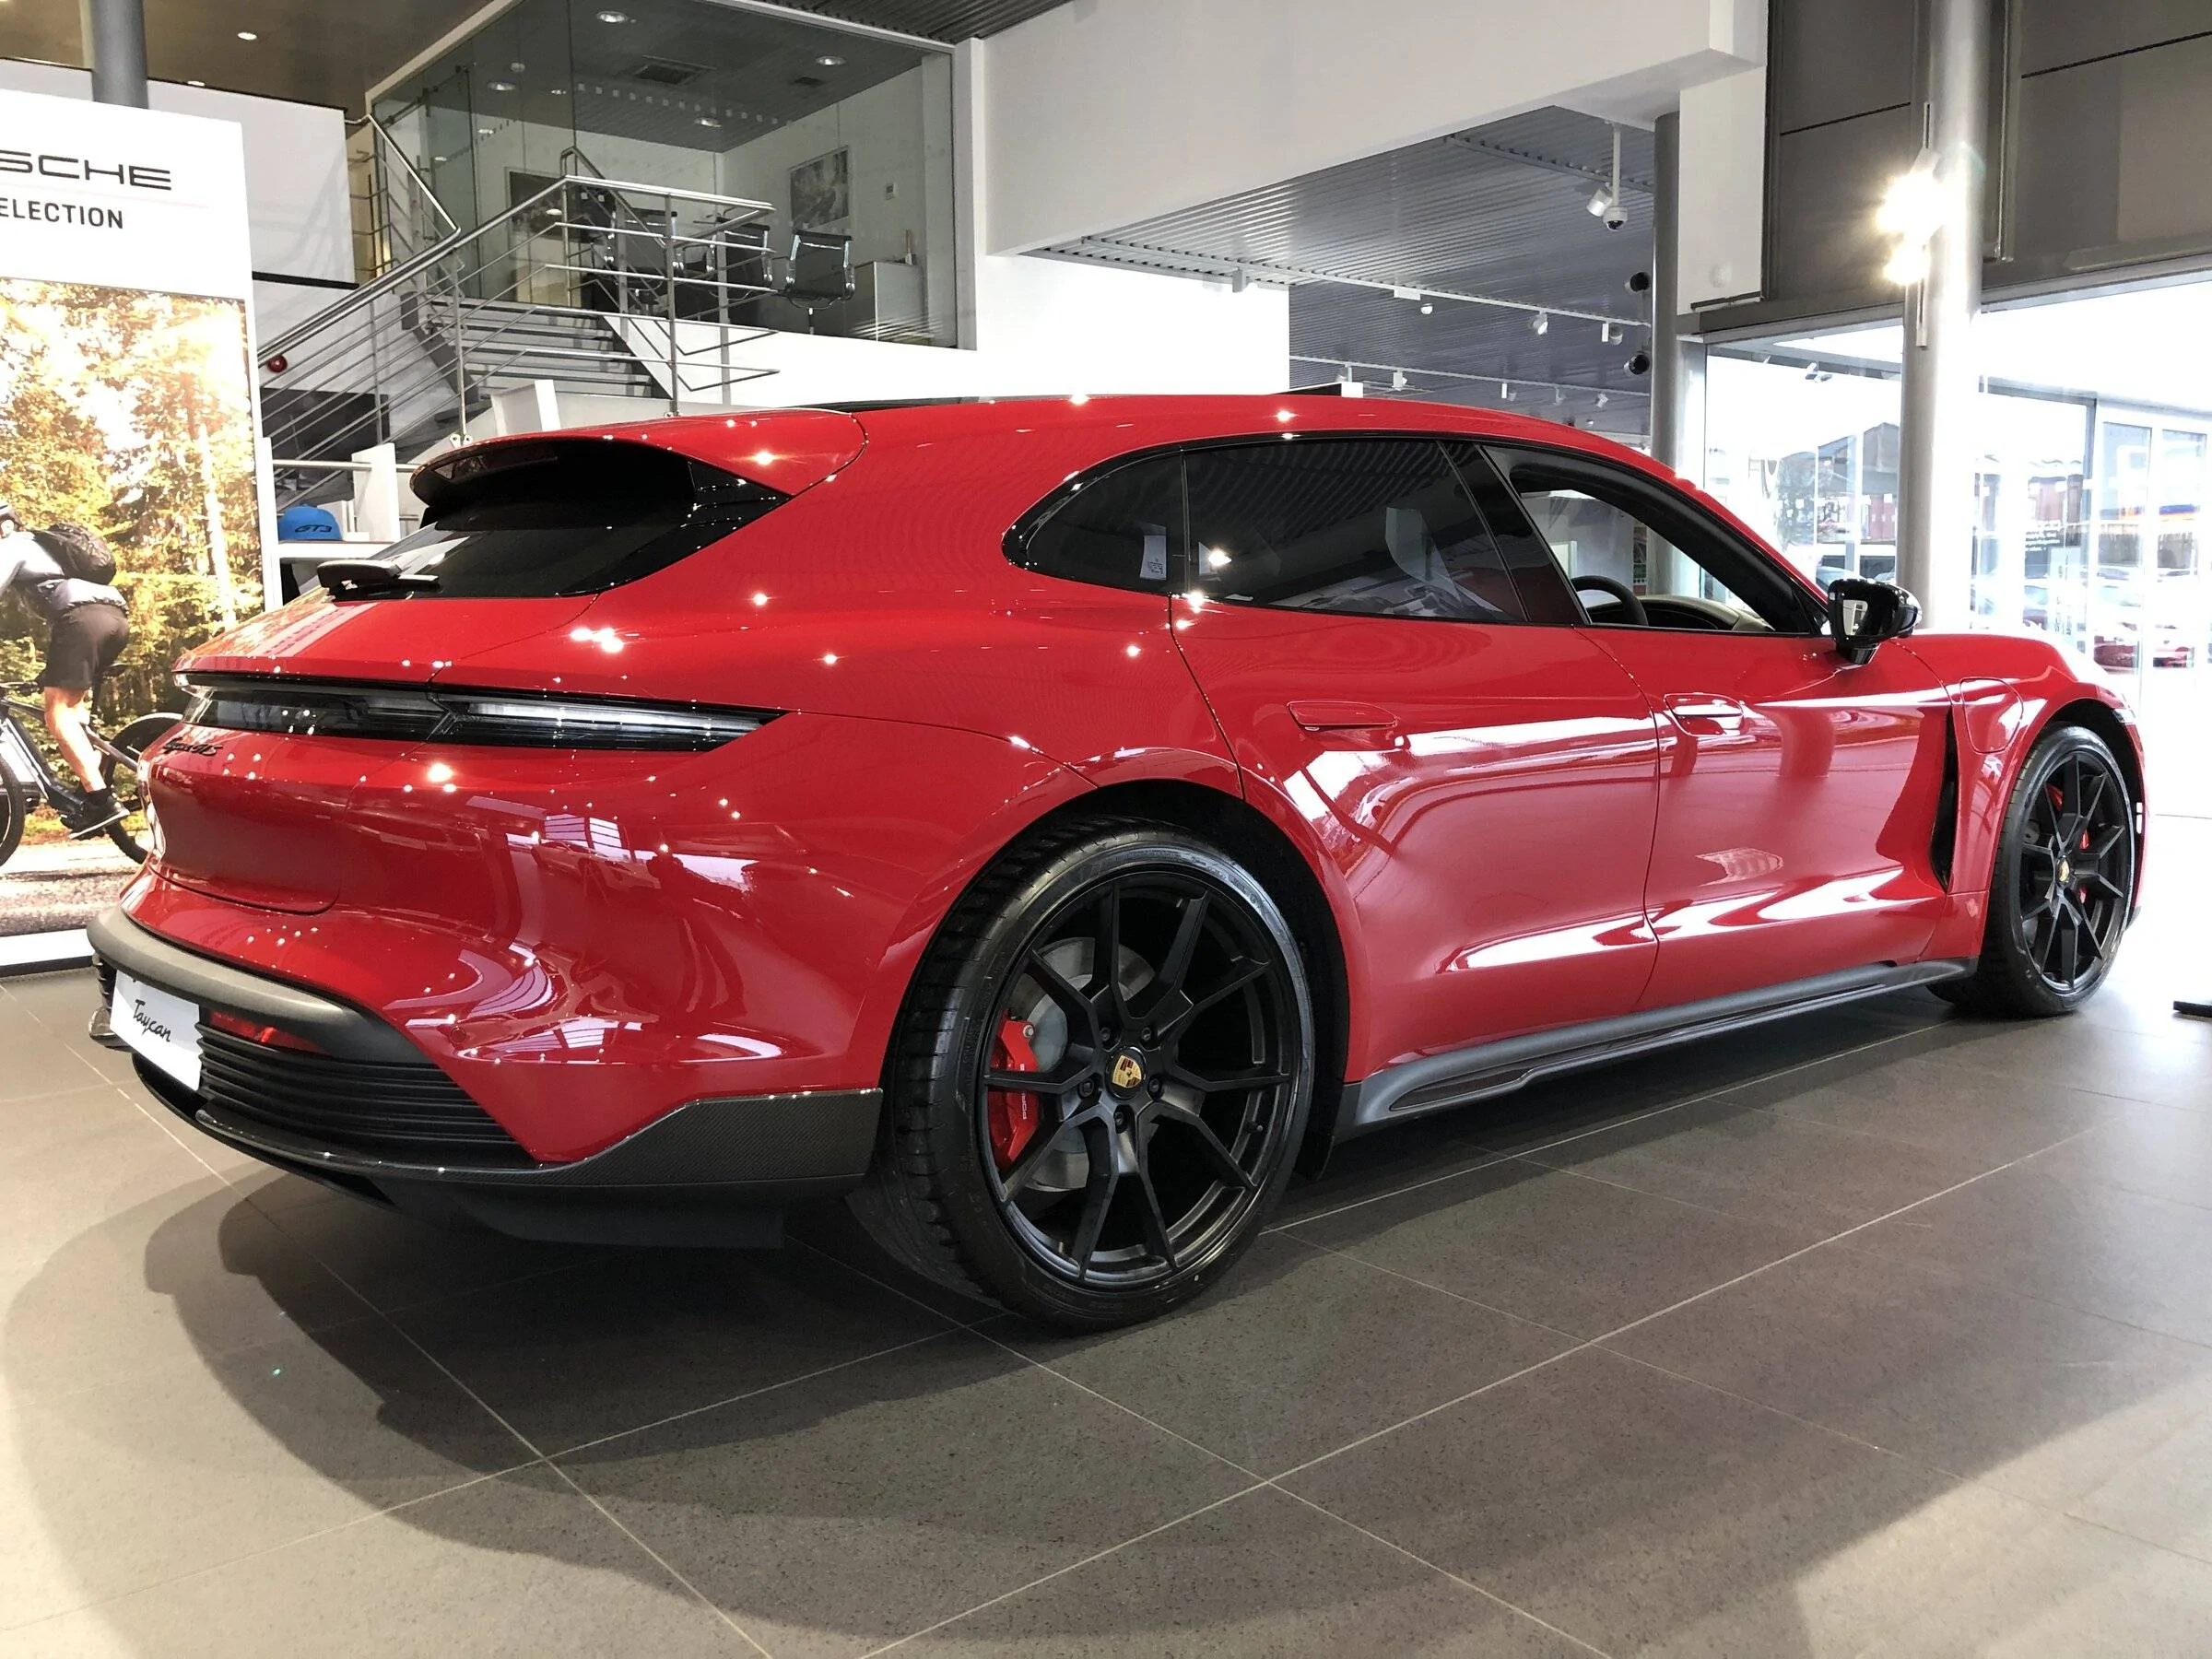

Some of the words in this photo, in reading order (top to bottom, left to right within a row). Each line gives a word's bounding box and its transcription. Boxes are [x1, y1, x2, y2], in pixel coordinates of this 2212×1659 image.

[0, 149, 172, 191] SCHE
[0, 197, 124, 229] ELECTION
[294, 524, 333, 533] GT3
[133, 998, 171, 1042] Taycan
